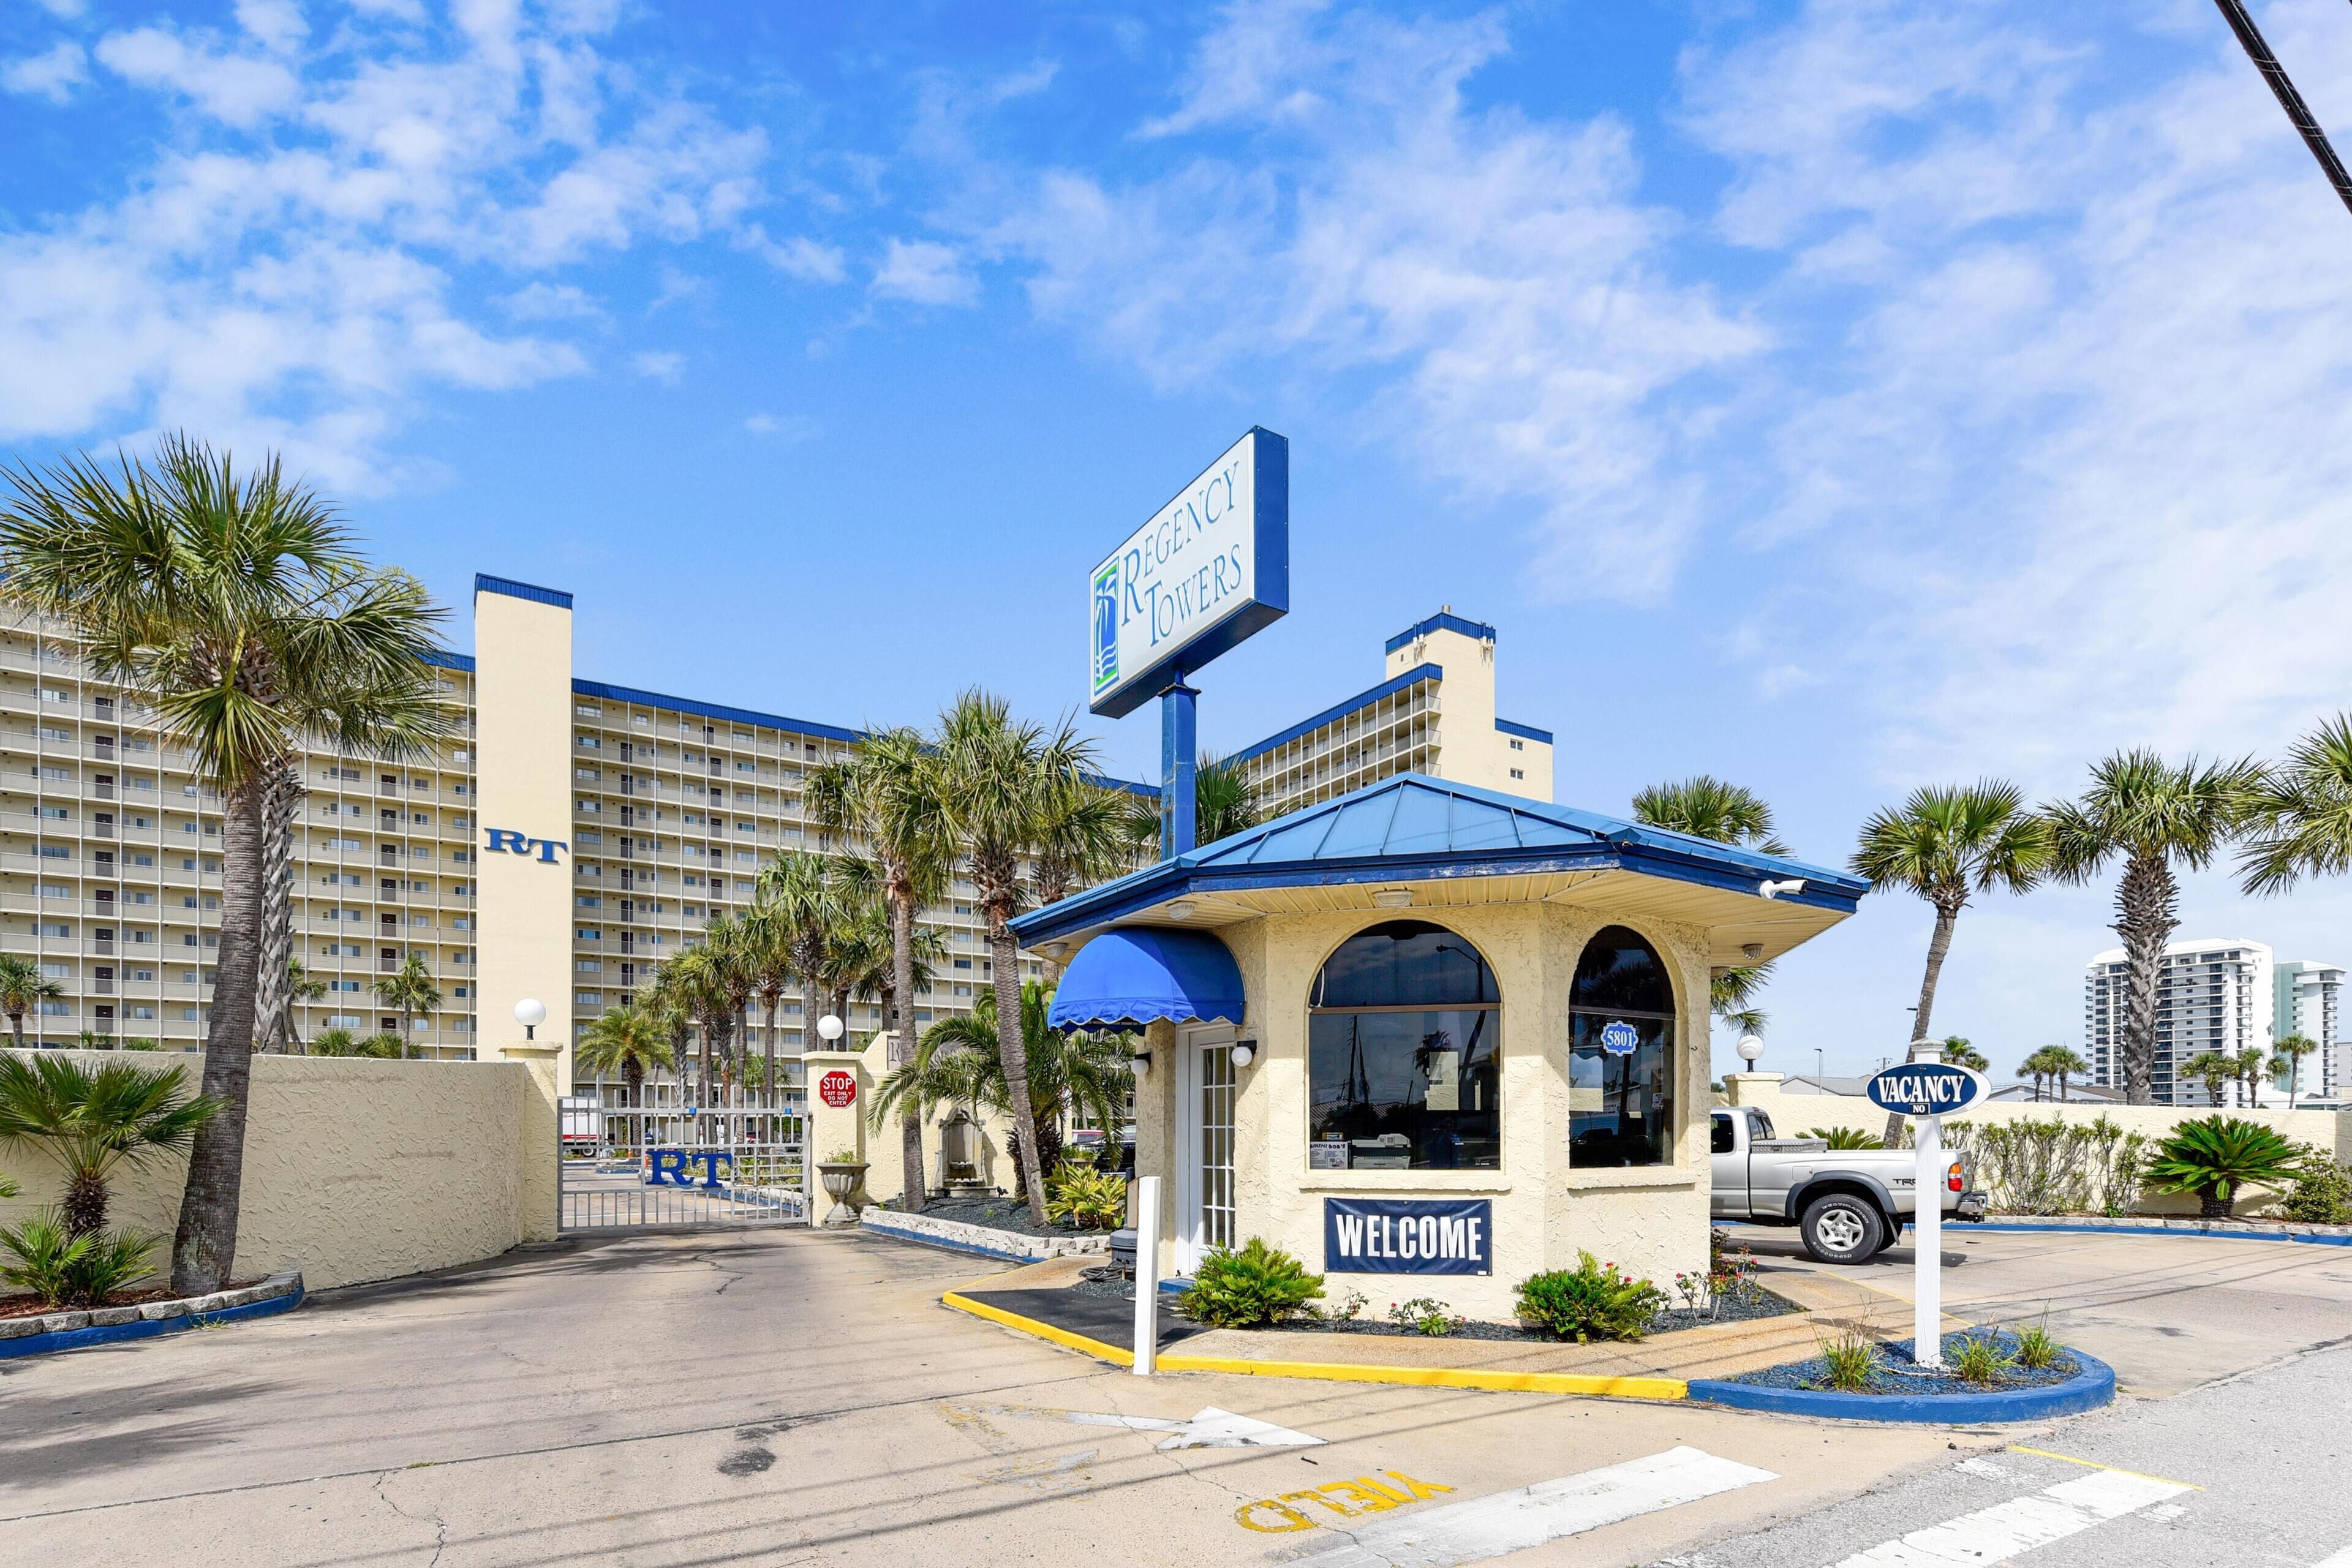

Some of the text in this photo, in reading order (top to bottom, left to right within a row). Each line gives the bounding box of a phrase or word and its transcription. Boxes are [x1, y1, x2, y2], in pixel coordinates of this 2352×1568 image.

[1121, 461, 1239, 627] REGENCY
[1144, 544, 1242, 648] TOWERS
[483, 827, 568, 863] RT
[1607, 1030, 1634, 1047] 5801
[823, 1077, 853, 1090] STOP
[1877, 1075, 1966, 1103] VACANCY
[1912, 1104, 1925, 1114] NO
[645, 1150, 733, 1188] RT
[1335, 1214, 1482, 1261] WELCOME
[1234, 1470, 1458, 1534] YIELD
